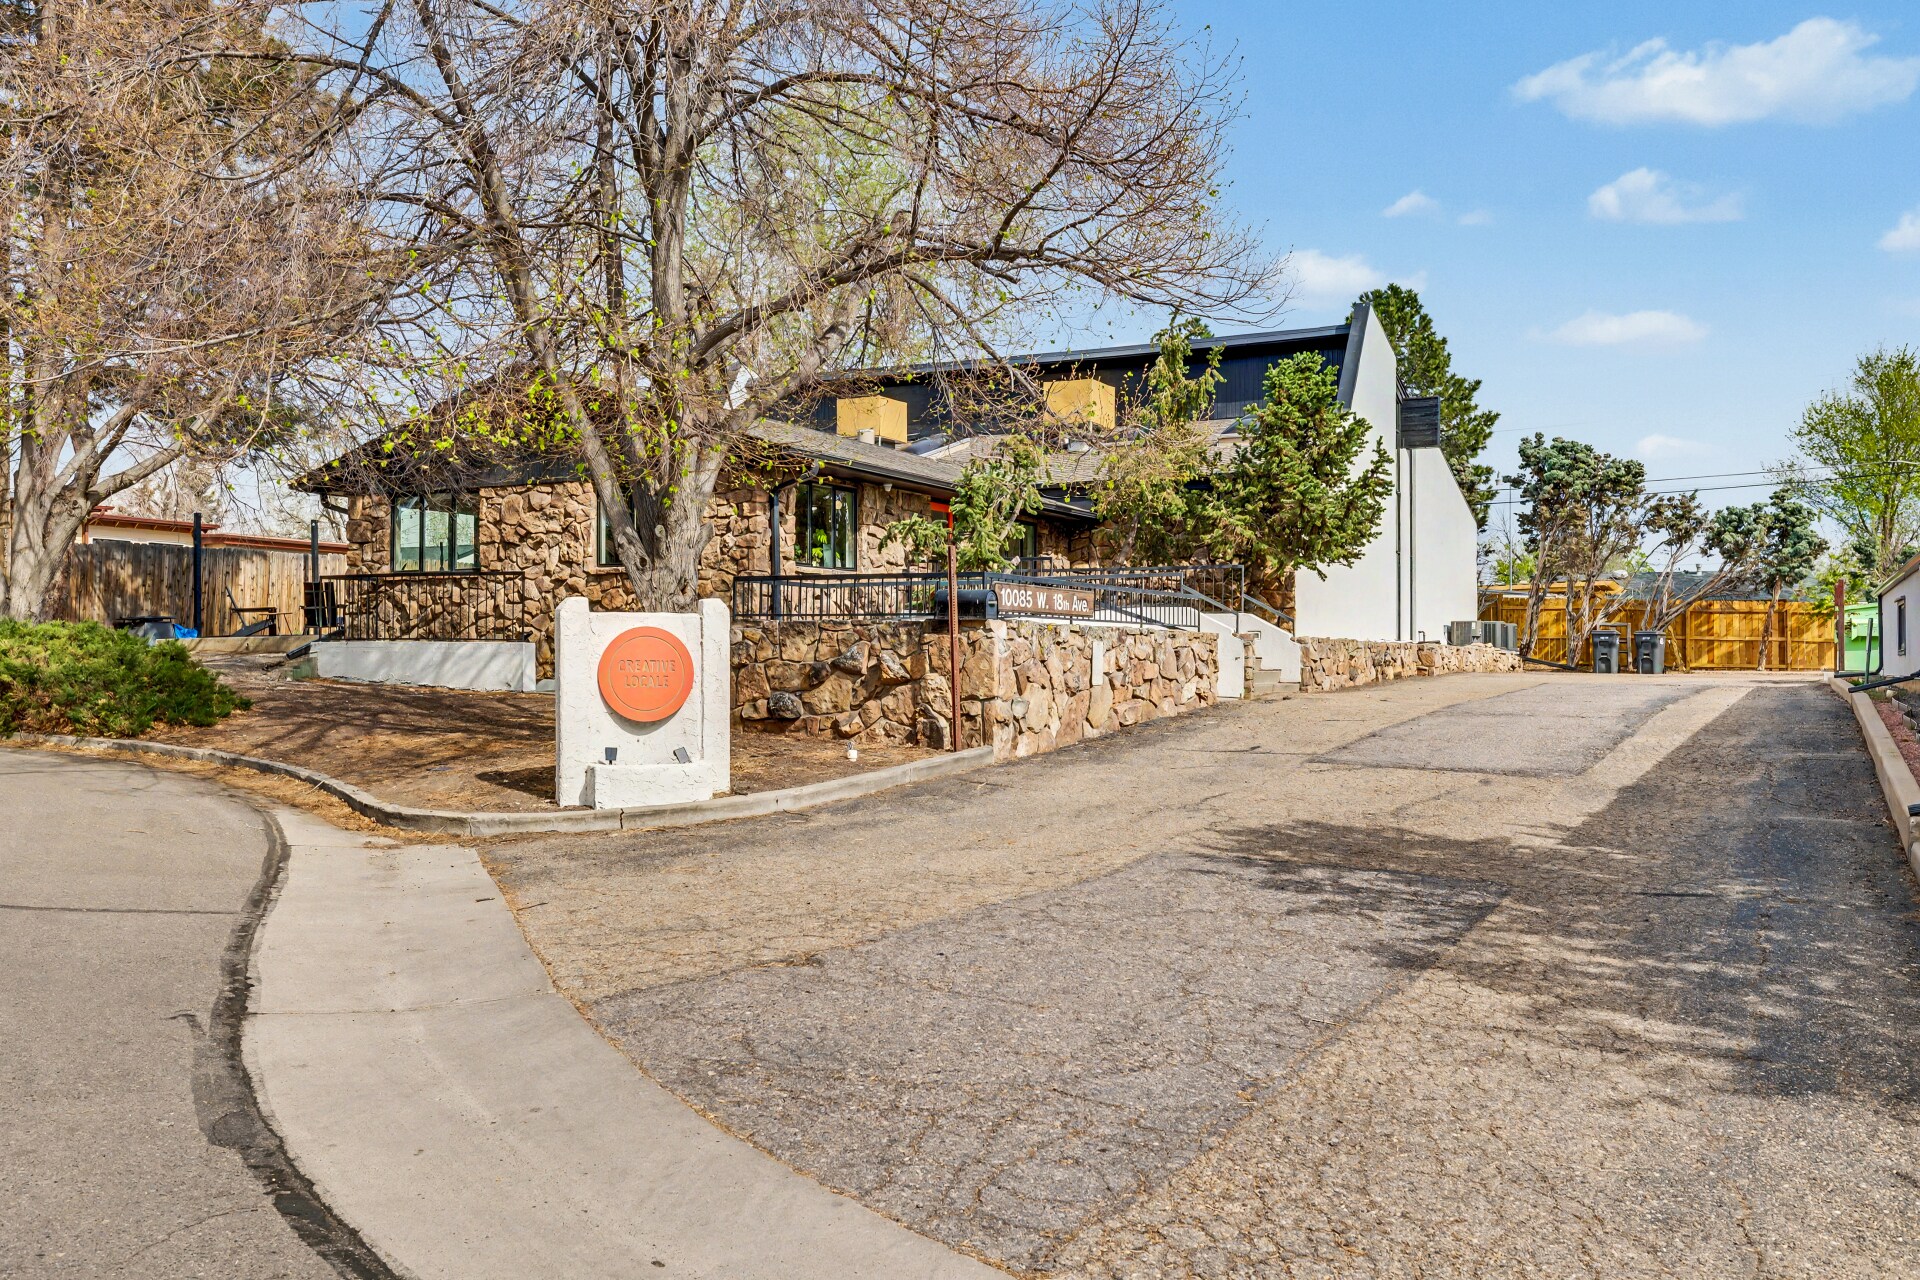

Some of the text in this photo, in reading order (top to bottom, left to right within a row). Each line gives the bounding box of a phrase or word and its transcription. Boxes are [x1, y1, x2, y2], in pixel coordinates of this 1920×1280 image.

[1001, 588, 1089, 613] 10085 W. 18th Ave.
[618, 659, 676, 672] CREATIVE
[625, 675, 669, 688] LOCALE
